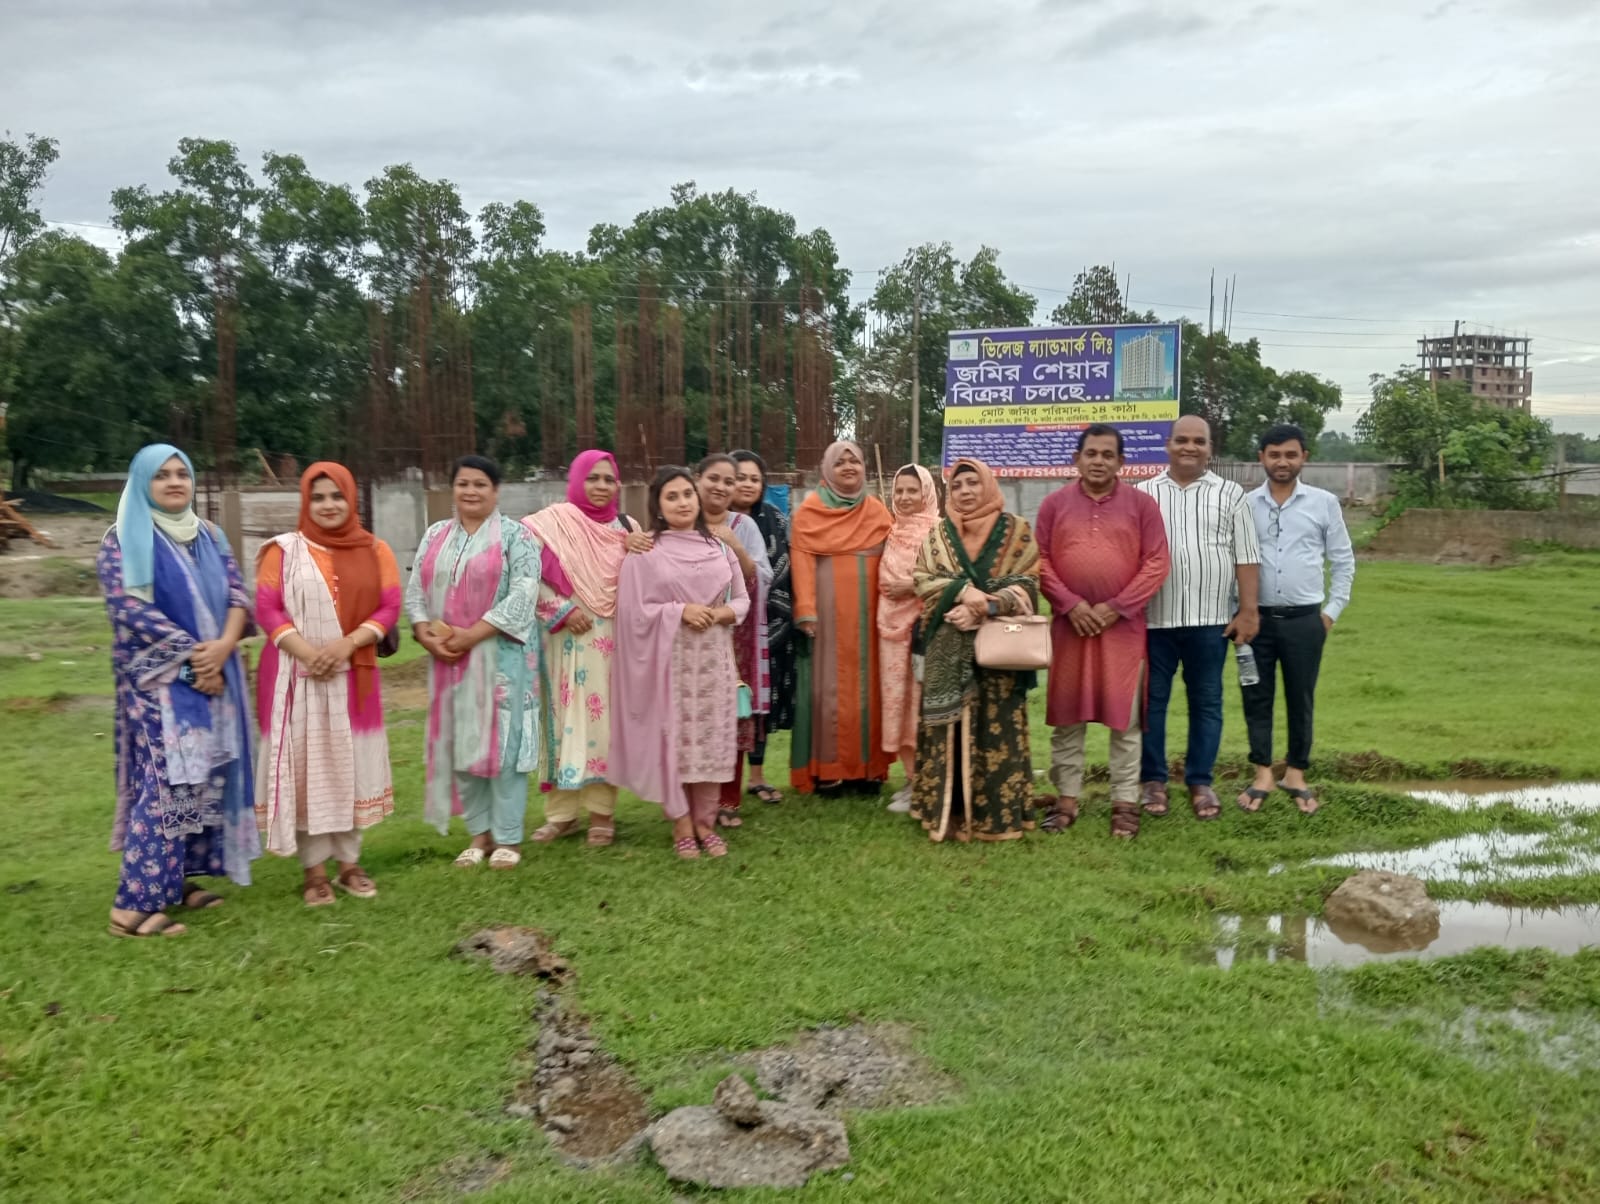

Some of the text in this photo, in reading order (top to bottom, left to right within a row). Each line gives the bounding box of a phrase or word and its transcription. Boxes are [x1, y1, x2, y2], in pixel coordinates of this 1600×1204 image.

[981, 336, 1025, 360] ভিলেজ
[1090, 331, 1113, 356] লিঃ
[953, 360, 1110, 383] জমির শেয়ার
[950, 381, 1110, 404] বিক্রয় চলছে...
[981, 407, 1004, 417] মোট
[1008, 406, 1037, 417] জমির
[1092, 405, 1106, 414] ১৪
[1112, 402, 1136, 413] কাঠা
